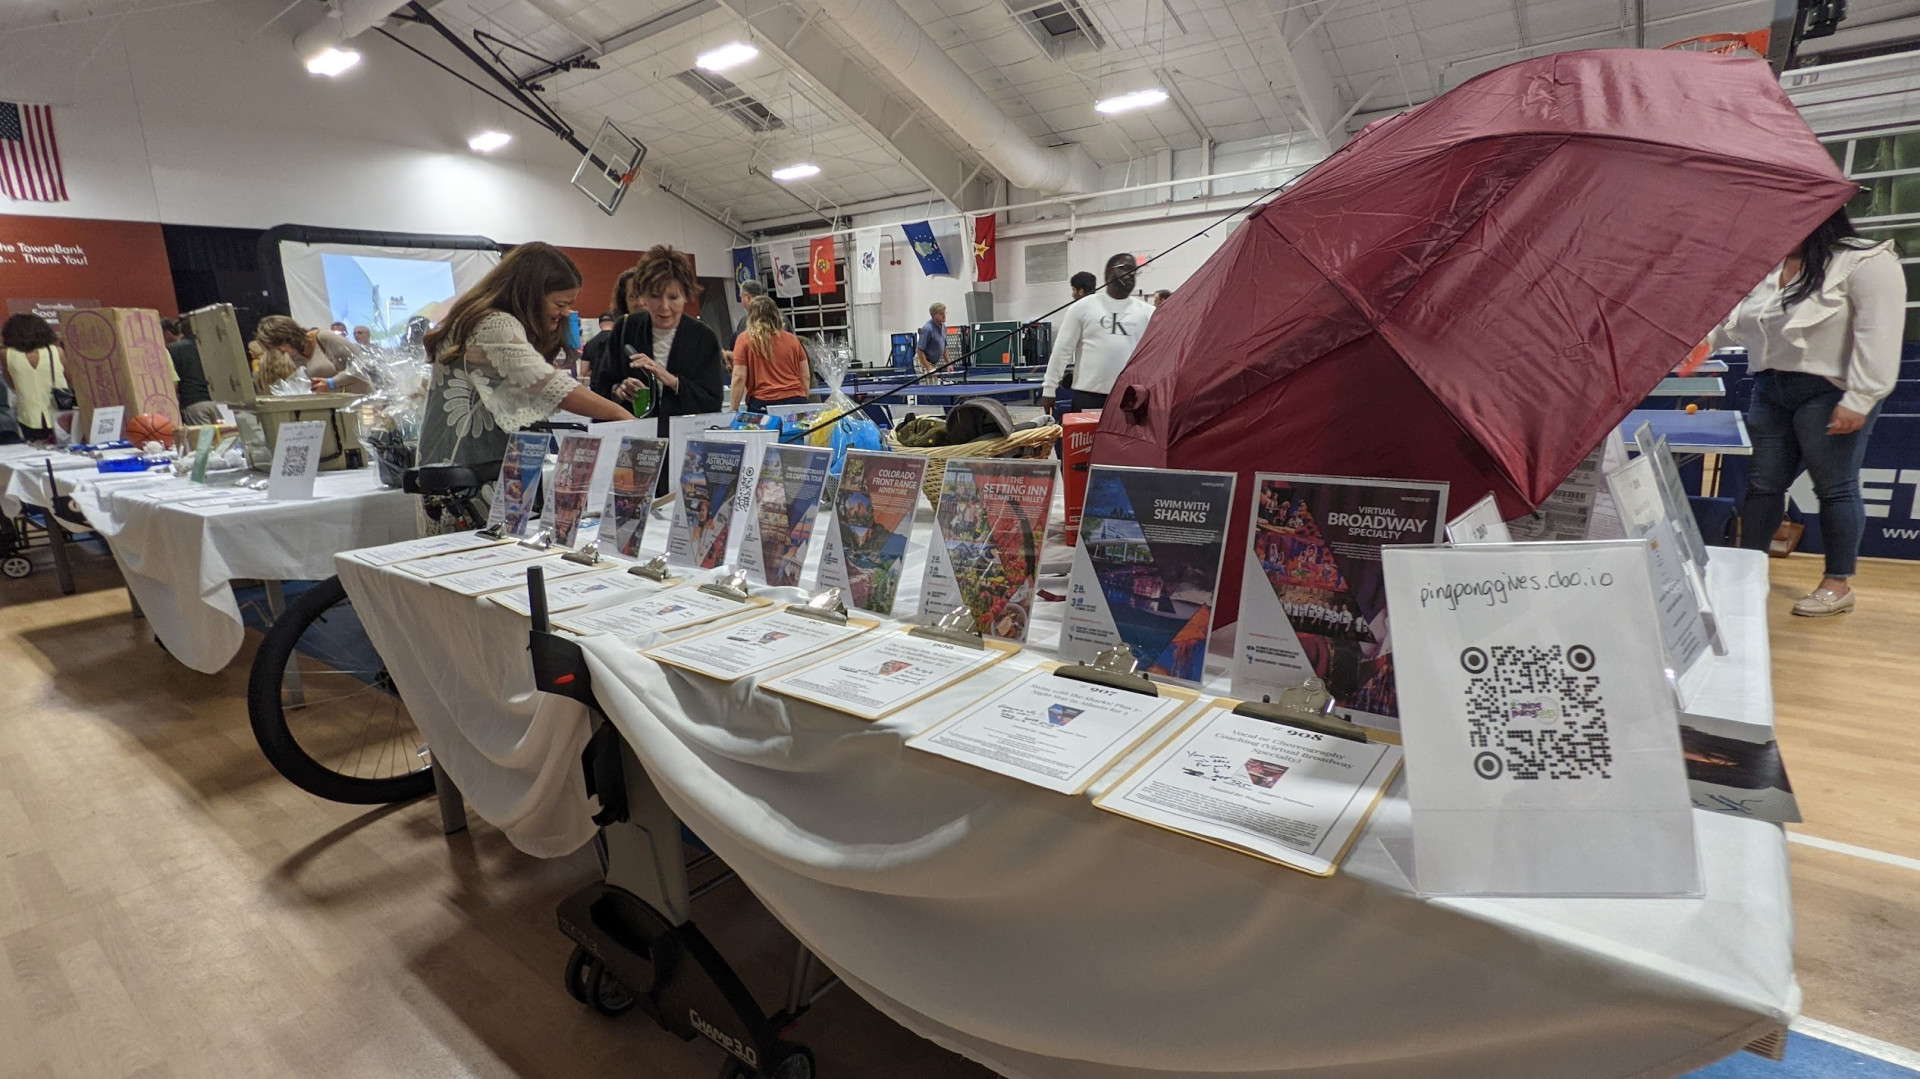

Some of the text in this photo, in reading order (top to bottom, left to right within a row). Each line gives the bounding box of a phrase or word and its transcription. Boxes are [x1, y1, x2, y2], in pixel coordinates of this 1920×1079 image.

[17, 242, 85, 255] TowneBank
[22, 253, 60, 265] Thank
[63, 254, 88, 265] You!
[706, 457, 741, 467] ASTRONAUT
[879, 469, 915, 479] COLORADO
[1010, 476, 1024, 484] THE
[872, 478, 918, 489] FRONT RANGE
[983, 483, 1048, 496] SETTING INN
[878, 487, 908, 496] ADVENTURE
[1154, 499, 1210, 511] SWIM WITH
[1358, 506, 1397, 516] VIRTUAL
[1153, 508, 1207, 523] SHARKS
[1327, 512, 1428, 533] BROADWAY
[1348, 527, 1402, 540] SPECIALTY
[1073, 584, 1079, 593] 2
[1420, 567, 1614, 611] pingponggives.cbo.io
[1071, 598, 1076, 607] 3
[1090, 687, 1118, 697] 907
[1287, 729, 1323, 741] 908
[1214, 732, 1356, 769] Coaching (Virtual Broadway
[1232, 729, 1257, 740] Vocal
[1272, 739, 1347, 760] Choreography
[1252, 747, 1302, 764] Specialty)
